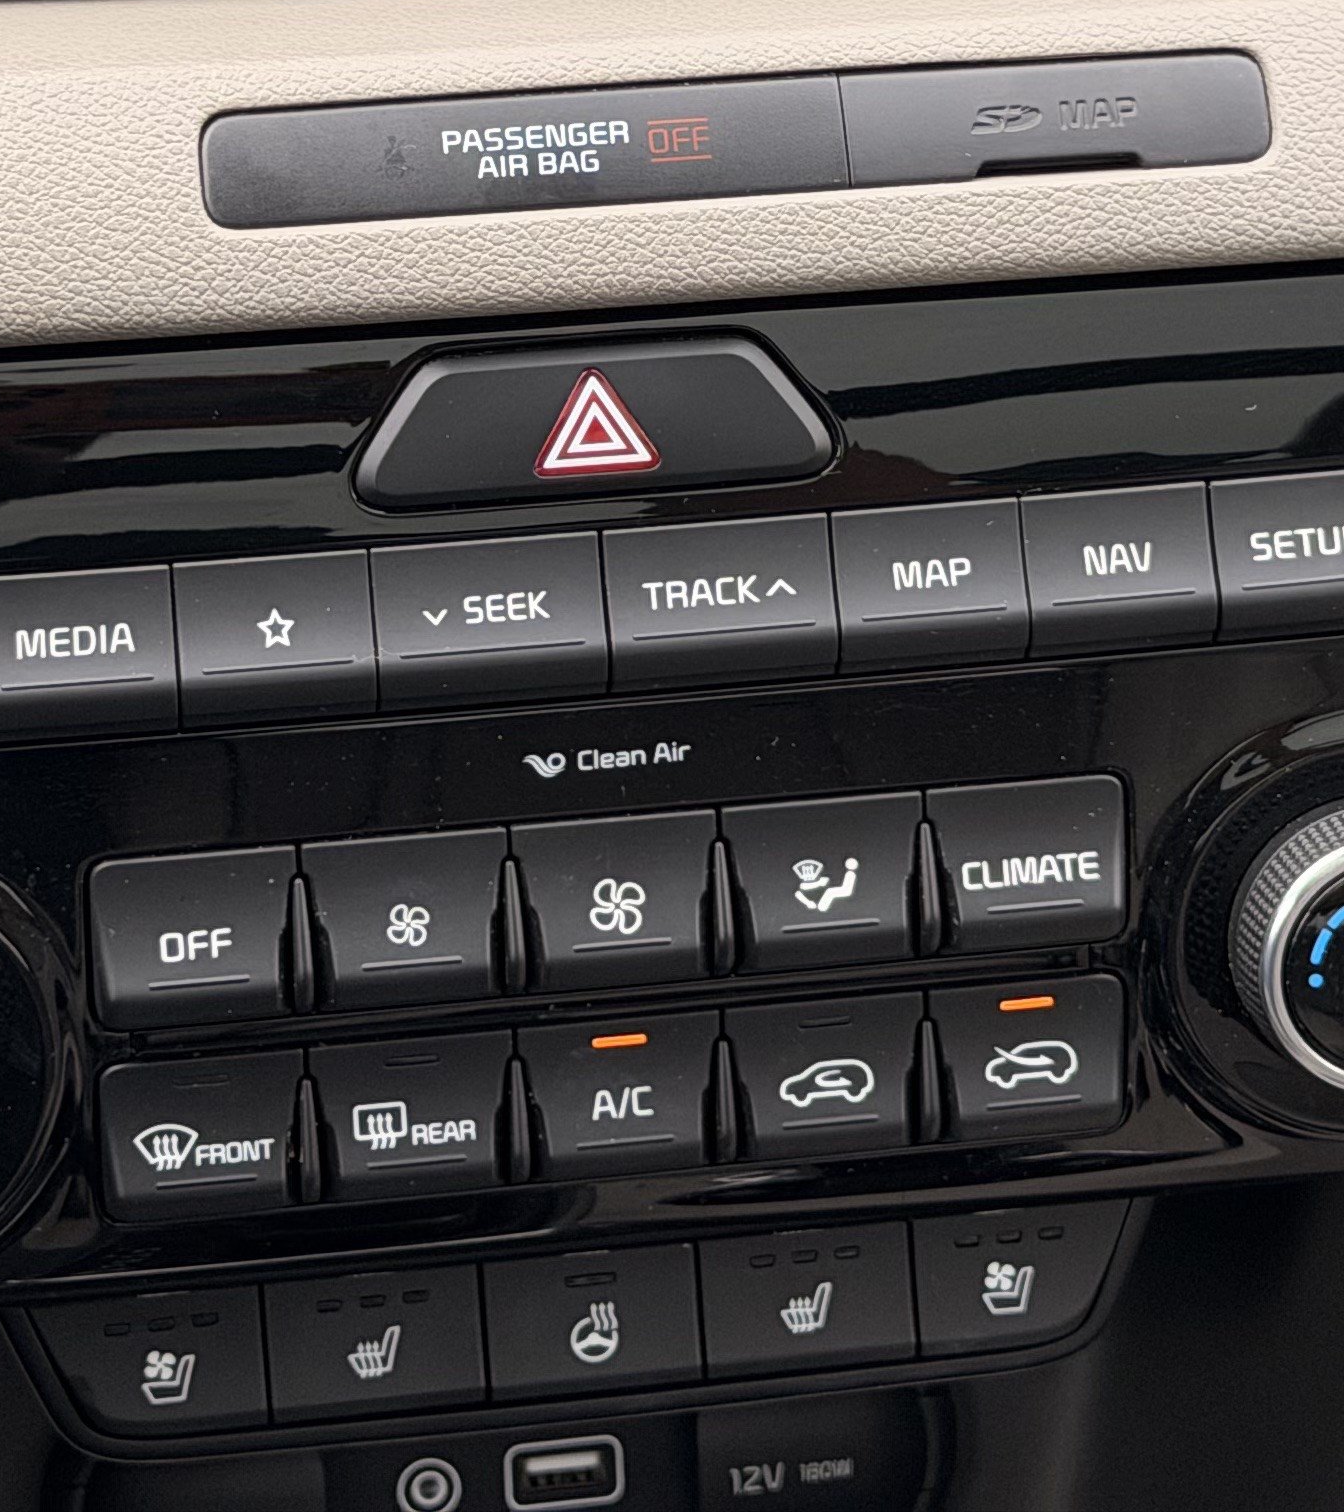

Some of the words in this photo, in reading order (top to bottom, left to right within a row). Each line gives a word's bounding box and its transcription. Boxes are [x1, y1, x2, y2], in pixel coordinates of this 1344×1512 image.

[1058, 96, 1138, 131] MAP
[440, 119, 630, 157] PASSENGER
[648, 122, 712, 158] OFF
[477, 151, 533, 179] AIR
[538, 148, 601, 175] BAG
[892, 558, 972, 591] MAP
[1083, 542, 1154, 576] NAV
[463, 591, 551, 625] SEEK
[642, 575, 761, 611] TRACK
[15, 623, 136, 660] MEDIA
[576, 746, 648, 772] Clean
[653, 741, 691, 765] Air
[961, 851, 1101, 892] CLIMATE
[159, 928, 233, 963] OFF
[591, 1087, 654, 1122] A/C
[411, 1119, 476, 1147] REAR
[195, 1136, 274, 1168] FRONT
[729, 1461, 785, 1495] 12V
